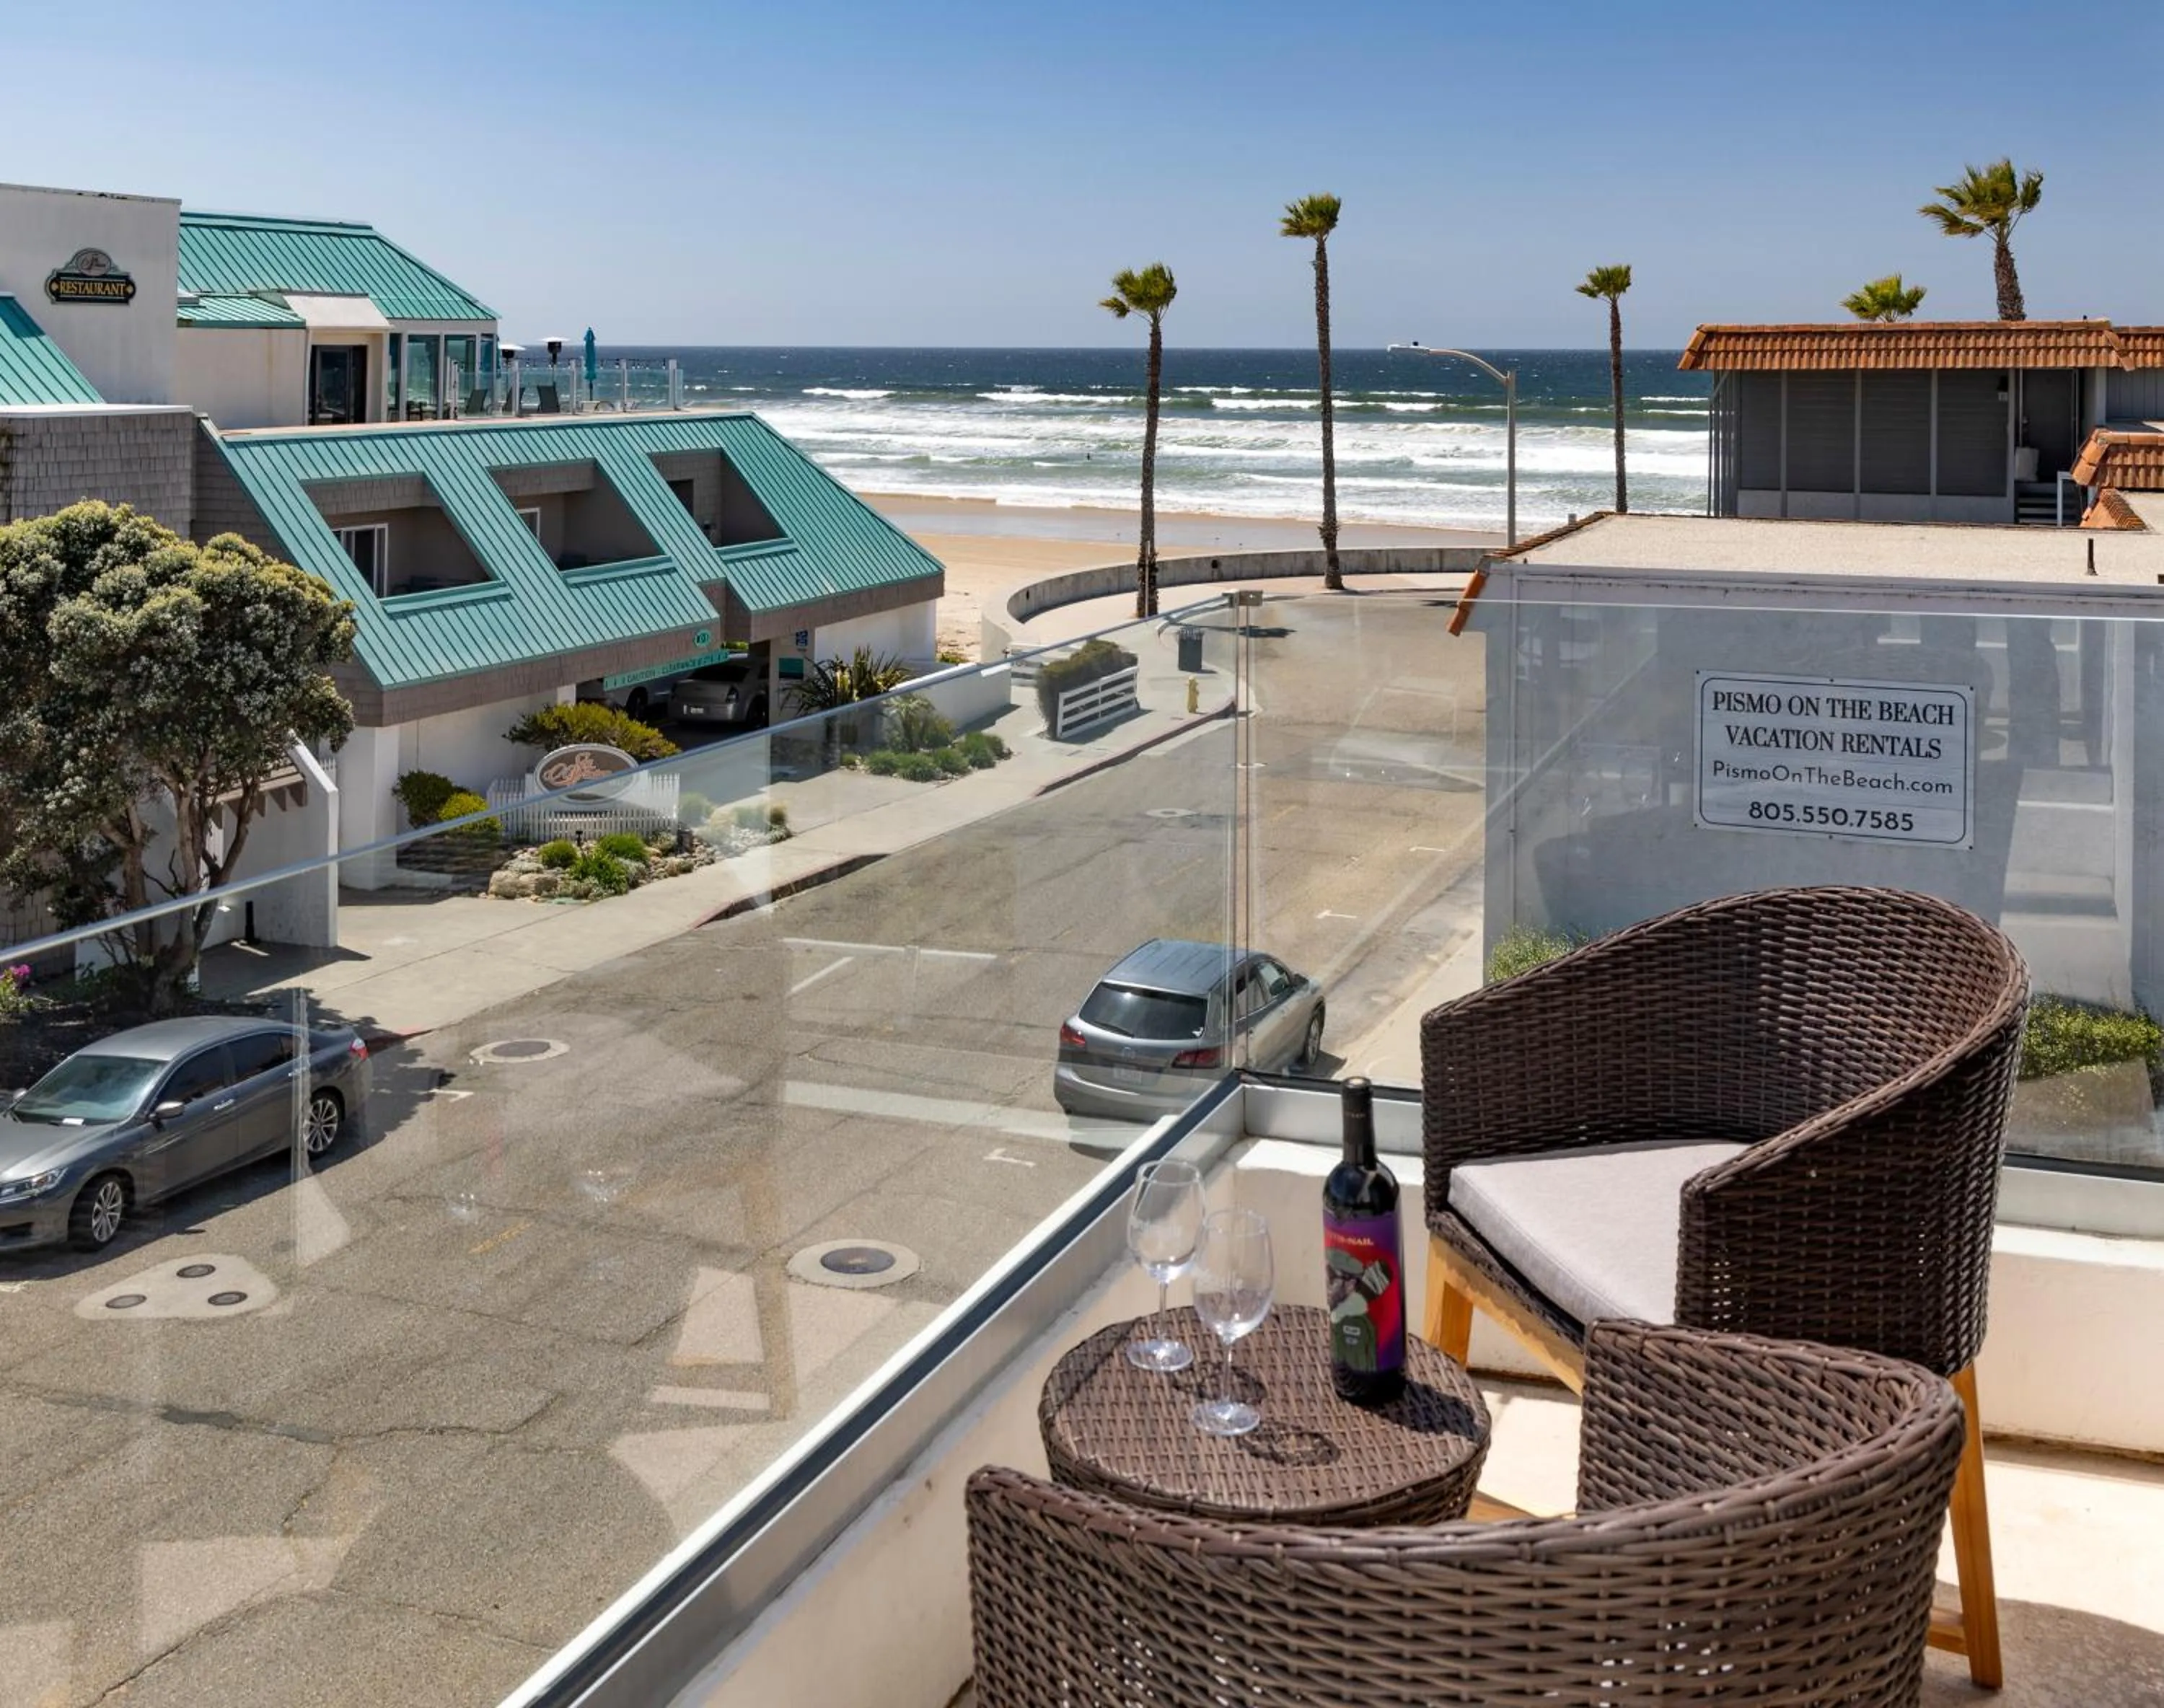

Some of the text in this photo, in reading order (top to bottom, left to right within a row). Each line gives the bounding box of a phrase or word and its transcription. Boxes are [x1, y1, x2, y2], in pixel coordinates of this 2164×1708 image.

[60, 281, 126, 296] RESTAURANT
[1712, 690, 1954, 726] PISMO ON THE BEACH
[1725, 725, 1942, 759] VACATION RENTALS
[1713, 760, 1953, 793] PismoOnTheBeach.com
[1749, 801, 1914, 832] 805.550.7585
